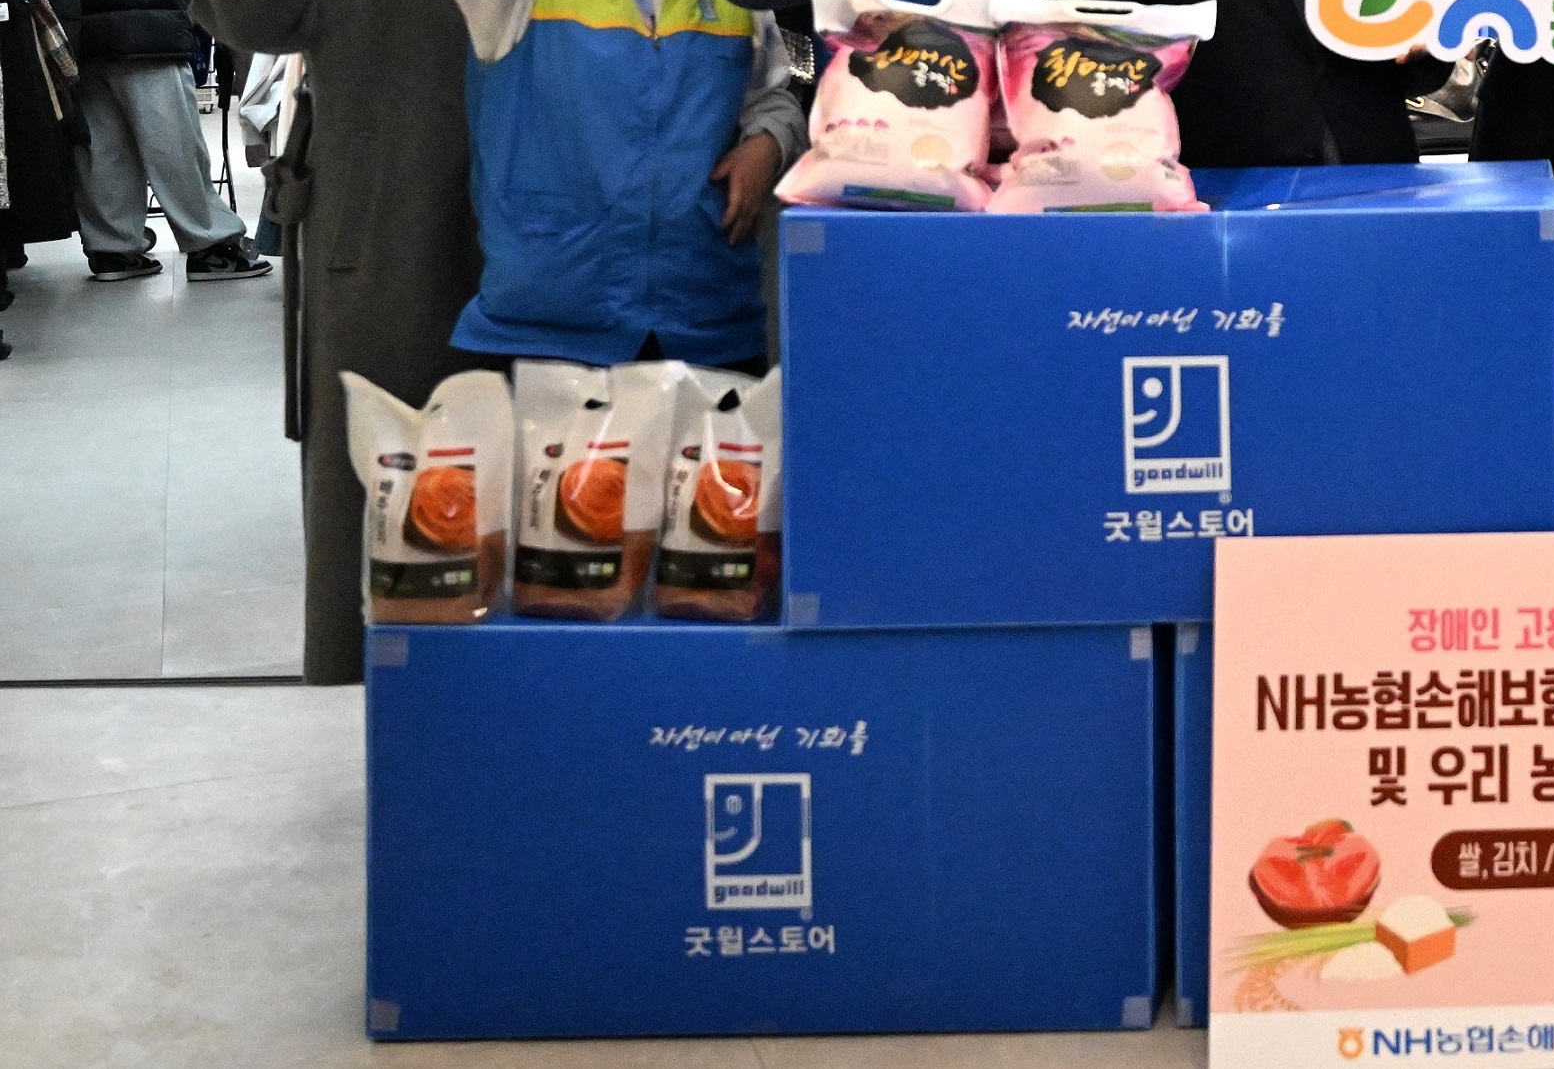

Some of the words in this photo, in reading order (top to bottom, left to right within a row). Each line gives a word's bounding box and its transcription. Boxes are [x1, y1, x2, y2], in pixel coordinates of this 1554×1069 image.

[1067, 307, 1143, 334] 자선이
[1147, 307, 1198, 333] 아닌
[1211, 301, 1286, 337] 기회를
[1134, 461, 1223, 487] goodwill
[1103, 508, 1255, 542] 굿윌스토어
[1407, 606, 1500, 653] 장애인
[649, 724, 727, 751] 자선이
[729, 724, 783, 751] 아닌
[795, 720, 869, 756] 기회를
[1367, 745, 1408, 808] 및
[1428, 744, 1511, 805] 우리
[713, 879, 804, 903] goodwill
[683, 924, 837, 957] 굿윌스토어
